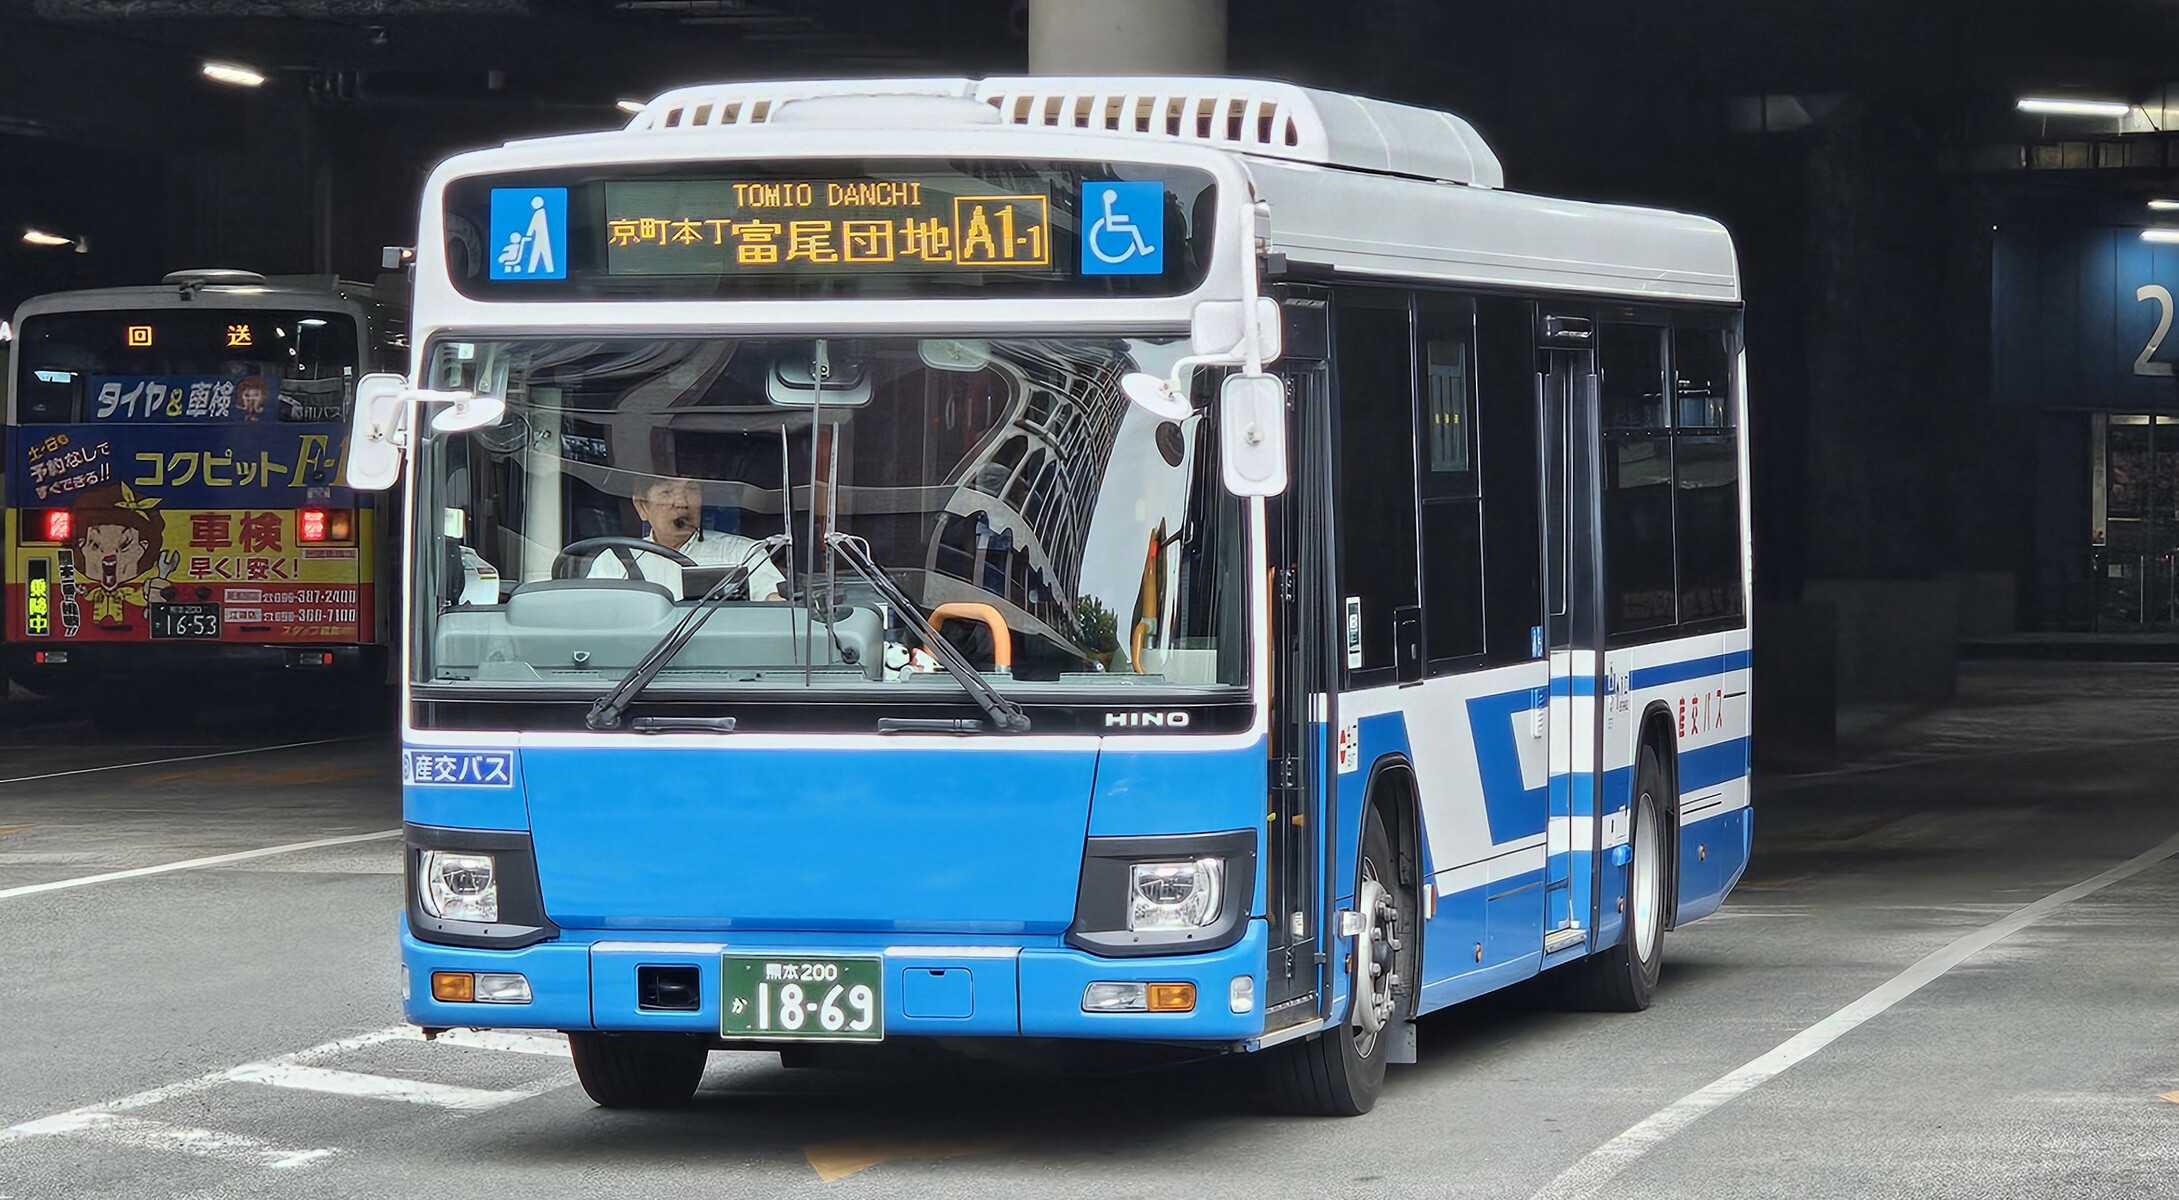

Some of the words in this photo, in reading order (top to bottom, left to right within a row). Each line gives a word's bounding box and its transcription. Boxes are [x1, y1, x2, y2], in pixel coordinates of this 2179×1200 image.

[732, 182, 812, 207] TOMIO
[828, 182, 921, 206] DANCHI
[608, 217, 732, 246] 京町本丁
[731, 217, 952, 264] 富尾団地
[2133, 284, 2175, 377] 2
[189, 511, 282, 553] 車検
[167, 615, 217, 635] 16-53
[1105, 712, 1190, 727] HINO
[415, 755, 508, 781] 産交バス
[758, 982, 873, 1031] 18-69
